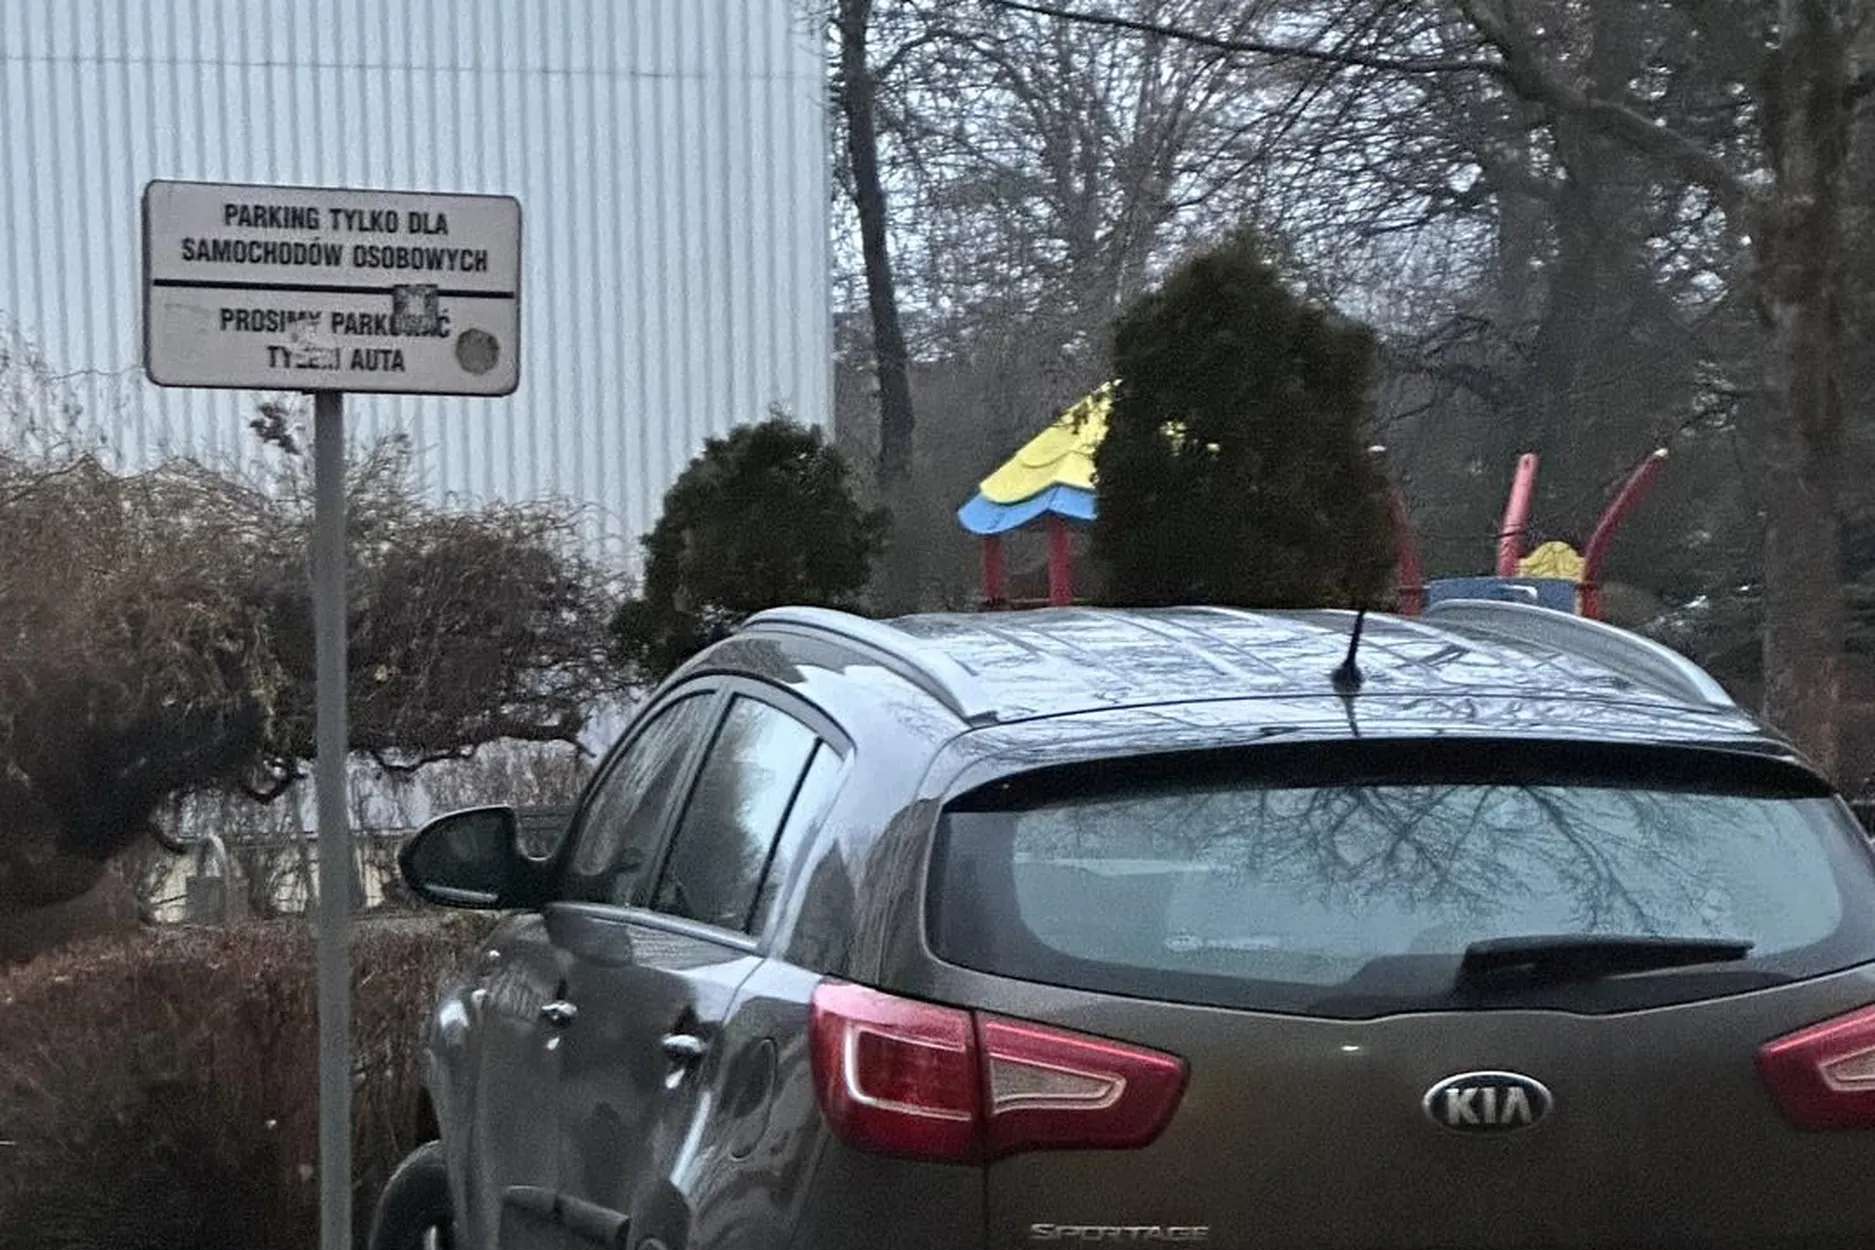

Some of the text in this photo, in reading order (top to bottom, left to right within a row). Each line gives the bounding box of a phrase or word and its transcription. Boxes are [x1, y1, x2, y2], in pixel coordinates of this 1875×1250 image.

[224, 203, 449, 236] PARKING TYLKO DLA
[181, 236, 488, 272] SAMOCHODÓW OSOBOWYCH
[331, 308, 451, 338] PARKĆ
[349, 348, 406, 372] AUTA
[1443, 1085, 1533, 1126] KIA
[1029, 1222, 1211, 1242] SPORTAGE
